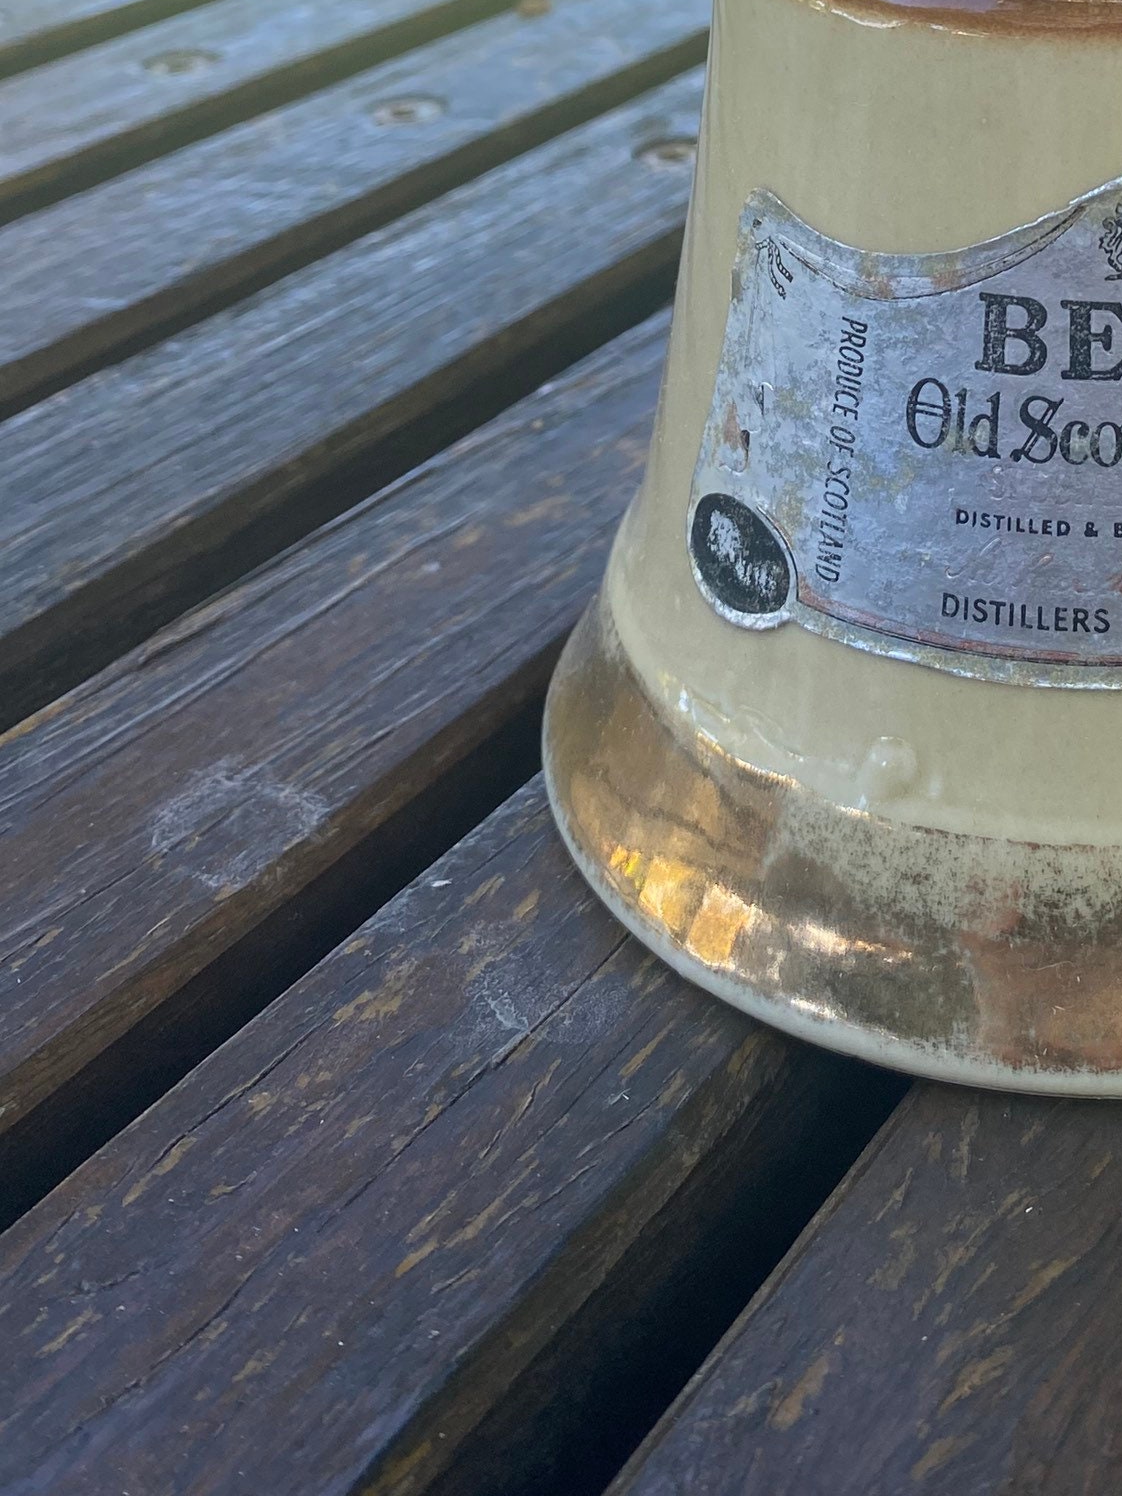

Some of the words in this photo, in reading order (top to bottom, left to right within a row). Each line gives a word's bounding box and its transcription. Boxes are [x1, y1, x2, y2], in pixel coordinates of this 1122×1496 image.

[831, 315, 868, 421] PRODUCE
[828, 425, 856, 458] OF
[905, 377, 1001, 460] Old
[814, 460, 852, 584] SCOTLAND
[955, 508, 1071, 537] DISTILLED
[1083, 521, 1099, 538] &
[941, 592, 1111, 634] DISTILLERS
